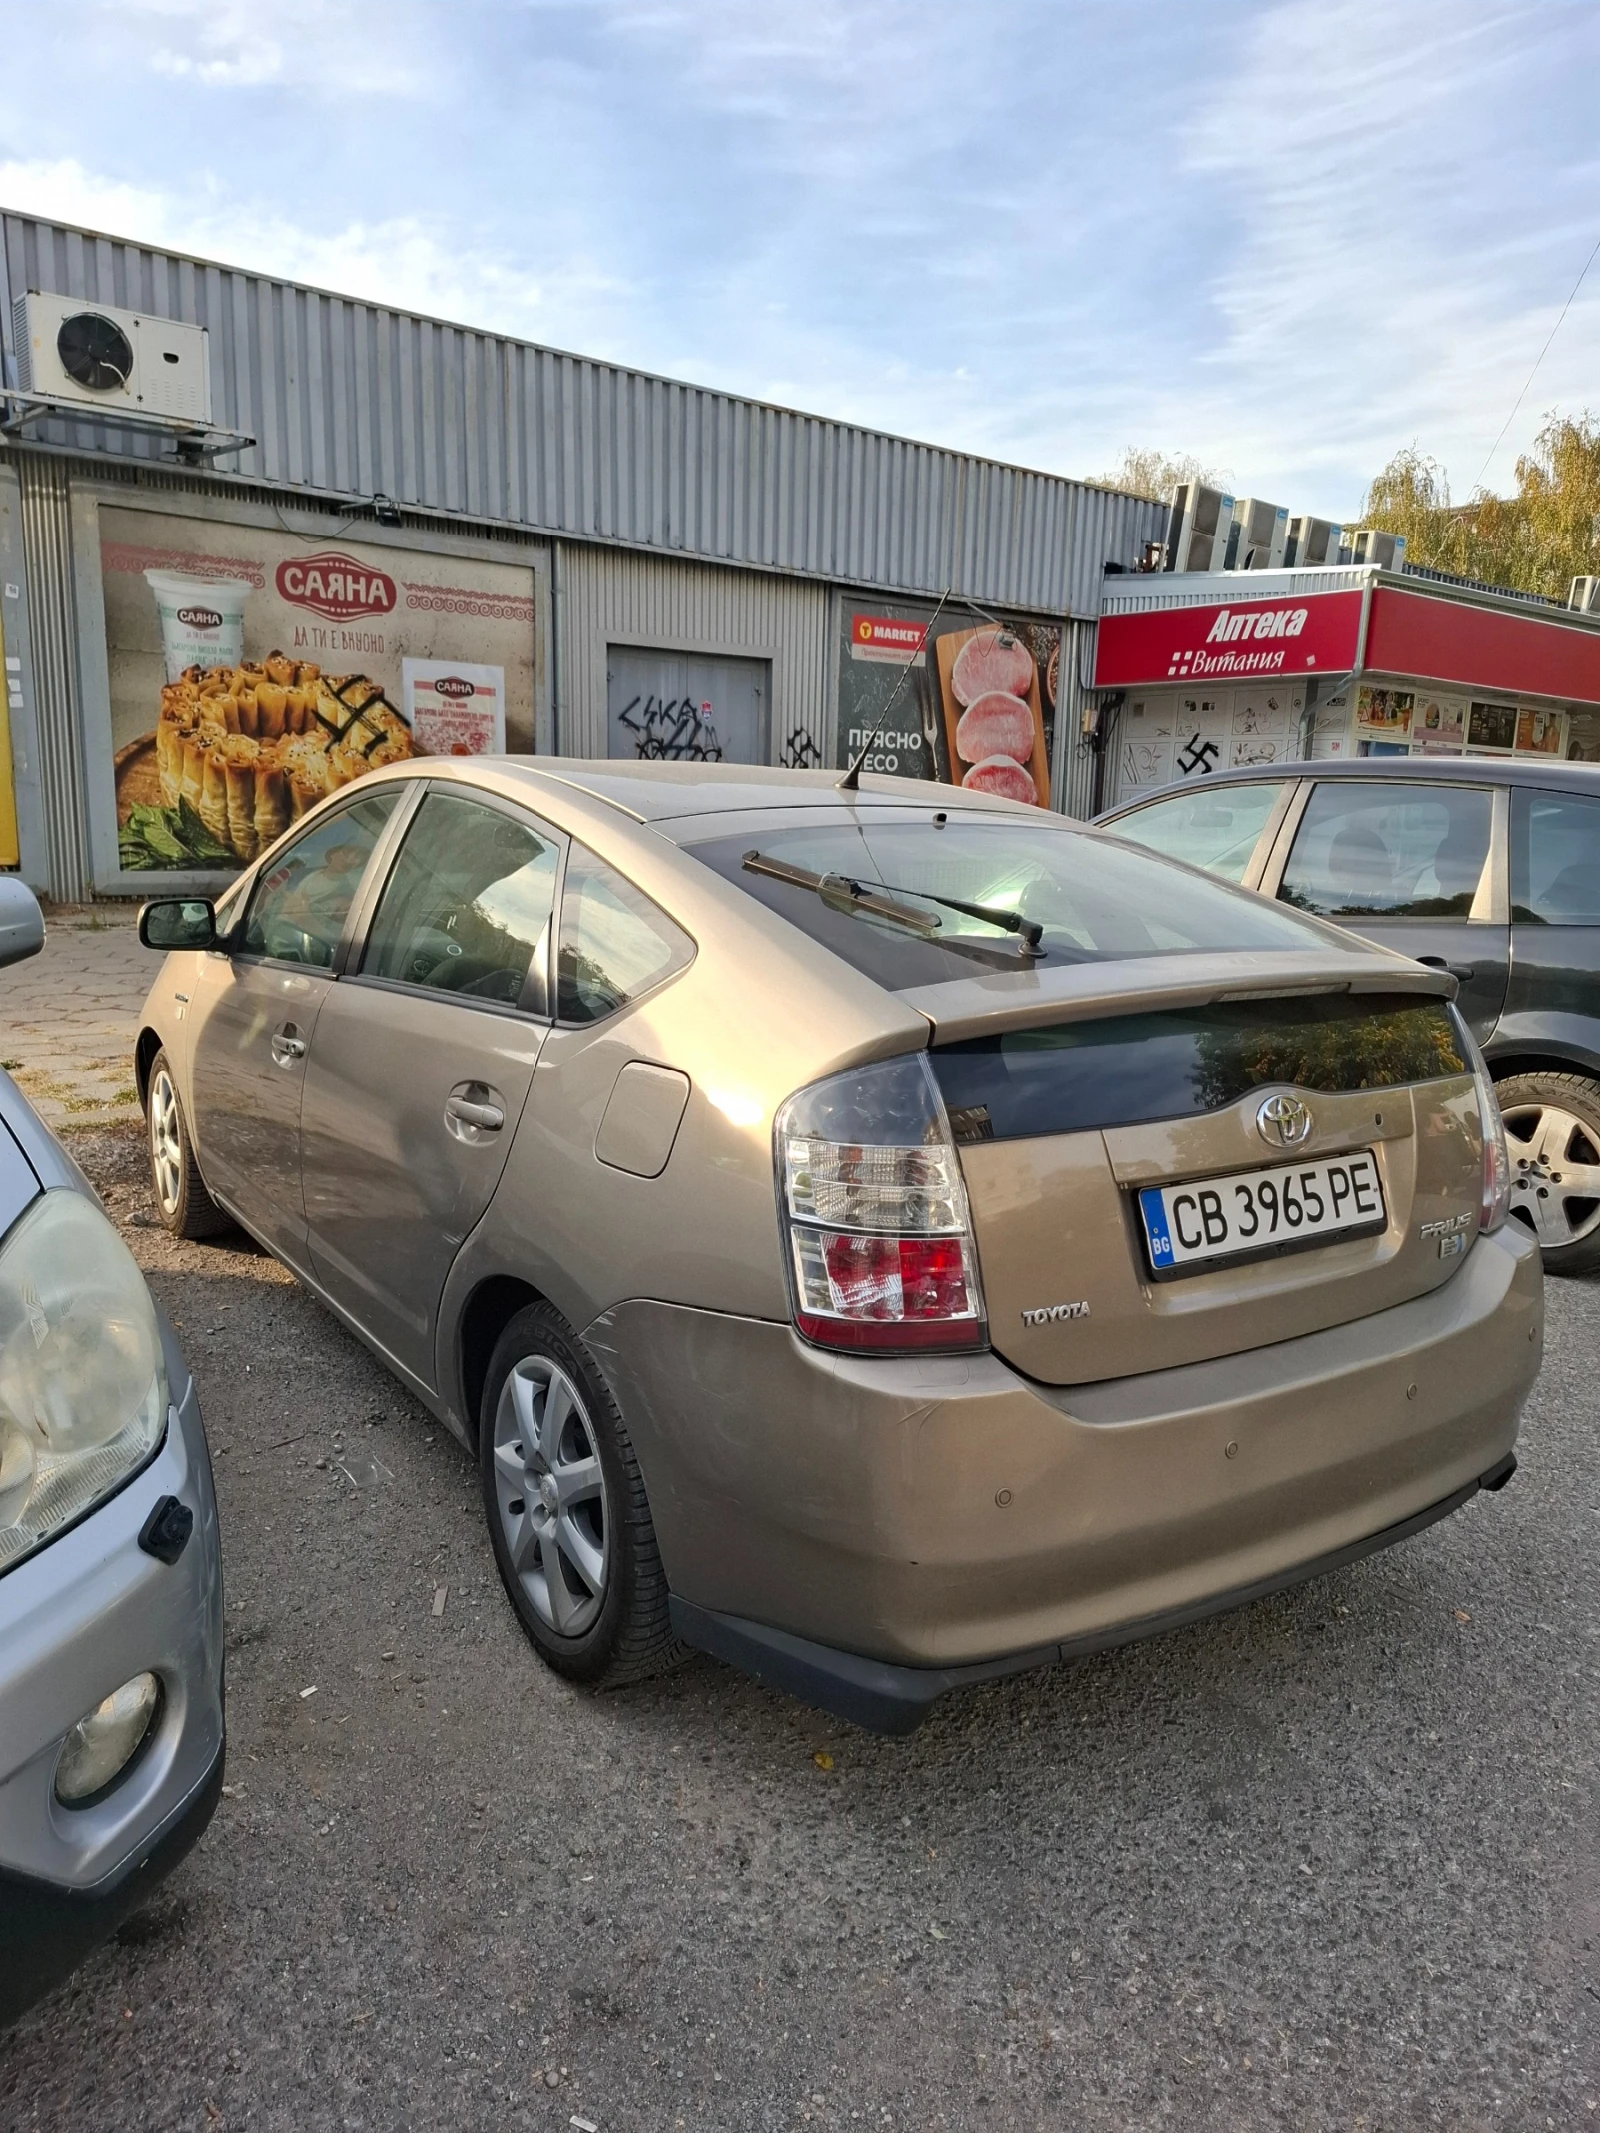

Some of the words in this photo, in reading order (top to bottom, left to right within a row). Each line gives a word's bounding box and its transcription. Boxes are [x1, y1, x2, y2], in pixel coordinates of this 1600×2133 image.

[284, 567, 389, 606] САЯНА
[180, 610, 220, 625] САЯНА
[1205, 608, 1308, 643] Аптека
[294, 626, 308, 647] ДА
[312, 628, 327, 648] ТИ
[331, 630, 337, 649] Е
[341, 631, 385, 654] ВКУСНО
[874, 626, 920, 642] MARKET
[1191, 650, 1285, 674] Витания
[437, 682, 473, 694] САЯНА
[848, 728, 922, 750] ПРЯСНО
[1172, 1190, 1228, 1250] CB
[1234, 1171, 1324, 1237] 3965
[1327, 1162, 1377, 1219] PE
[1420, 1211, 1472, 1240] PRIUS
[1152, 1237, 1170, 1255] BG
[1021, 1301, 1091, 1328] TOYOTA
